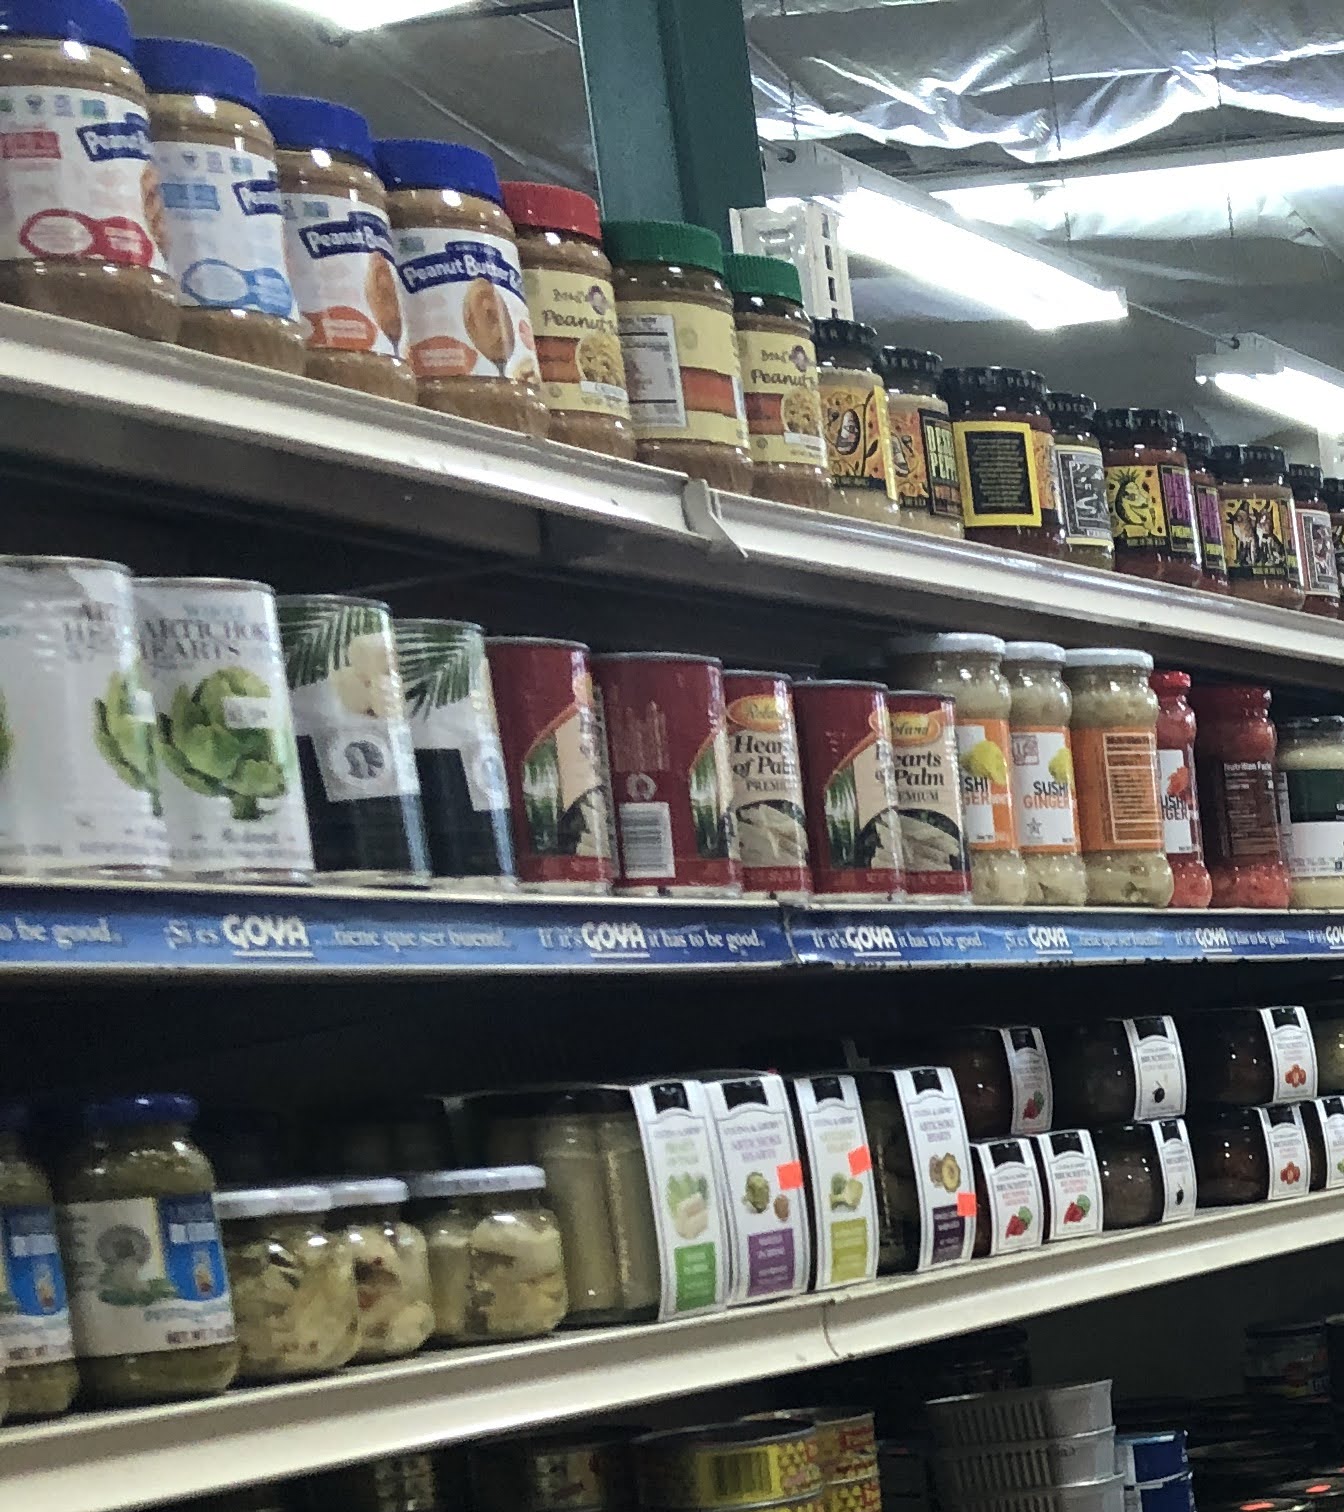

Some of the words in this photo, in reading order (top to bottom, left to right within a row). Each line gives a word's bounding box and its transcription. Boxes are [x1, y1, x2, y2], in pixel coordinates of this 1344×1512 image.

[403, 260, 462, 289] Peanut
[1033, 781, 1070, 796] SUSHI
[1023, 795, 1070, 809] GINGER
[223, 915, 310, 950] GOYA
[581, 922, 645, 951] GOYA
[662, 931, 686, 947] has
[704, 930, 723, 947] be
[845, 926, 895, 953] GOYA
[1028, 926, 1068, 950] GOYA
[1195, 927, 1229, 948] GOYA
